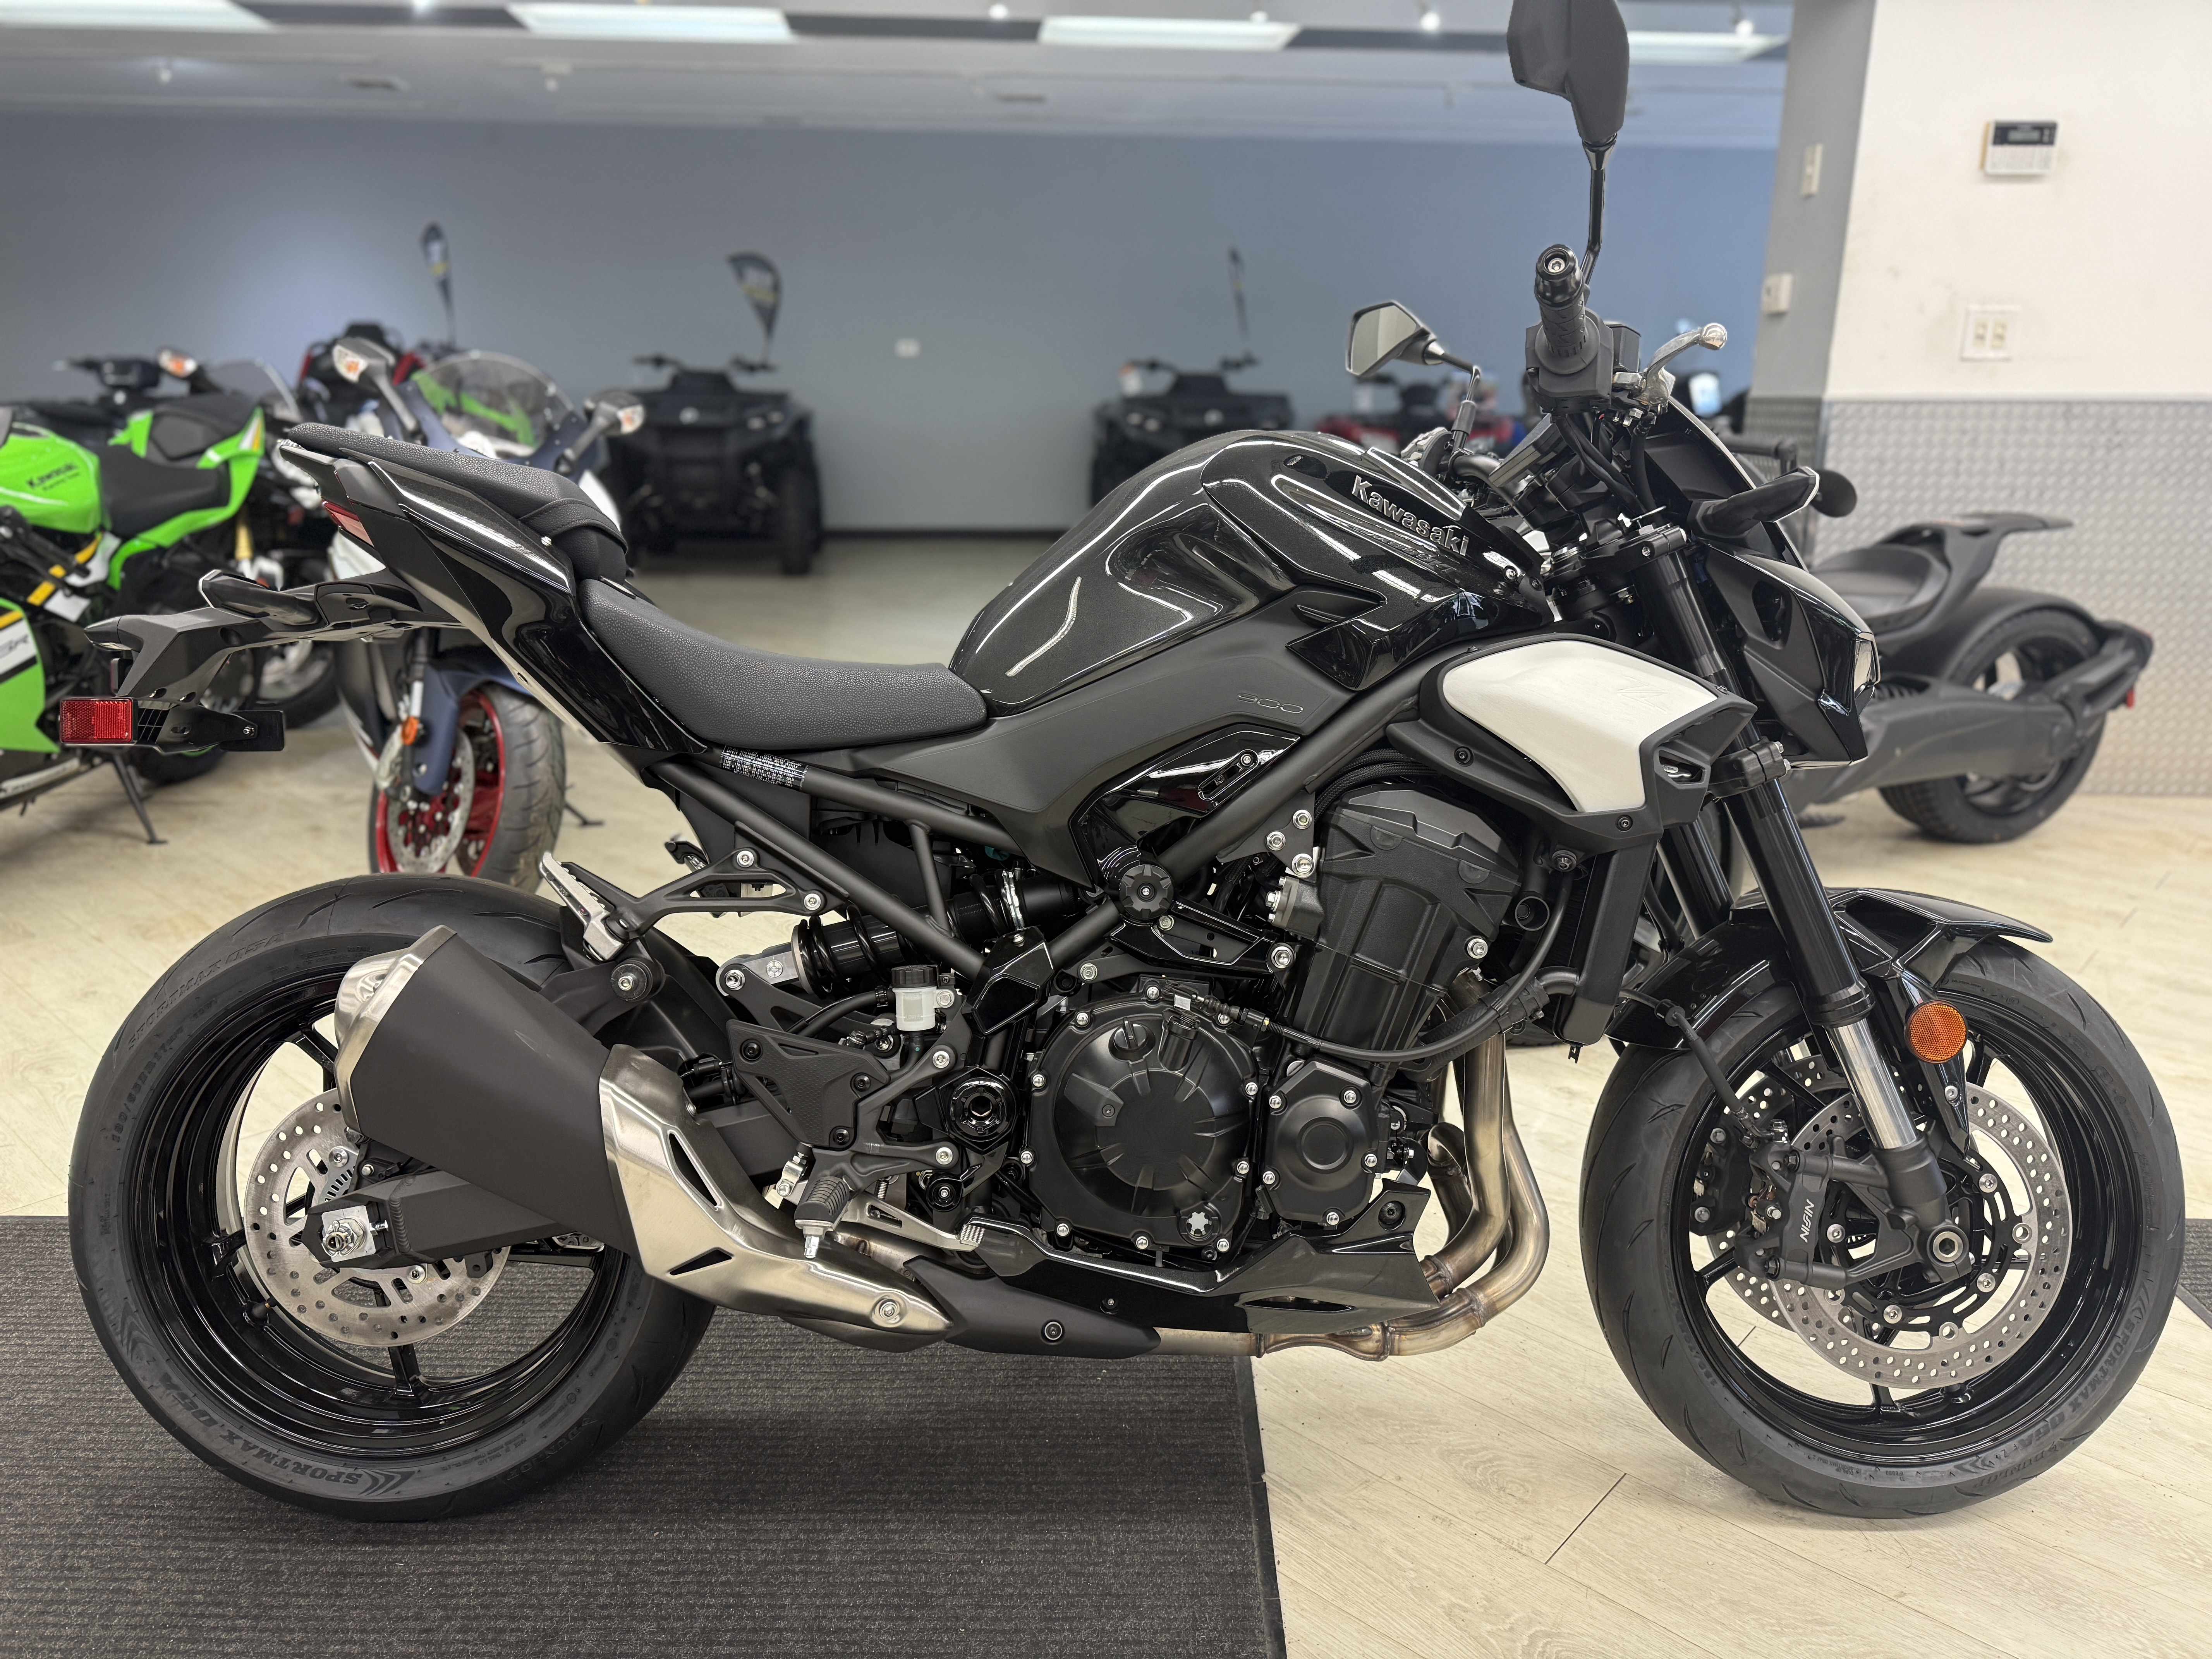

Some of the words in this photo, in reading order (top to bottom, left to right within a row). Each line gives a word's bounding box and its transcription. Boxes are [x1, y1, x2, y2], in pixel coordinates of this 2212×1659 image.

[1352, 475, 1470, 557] Kawasaki
[1236, 692, 1304, 714] 900
[1800, 1199, 1815, 1243] NISSIN
[2066, 1317, 2137, 1413] SPORTMAX
[219, 1427, 362, 1486] SPORTMAX
